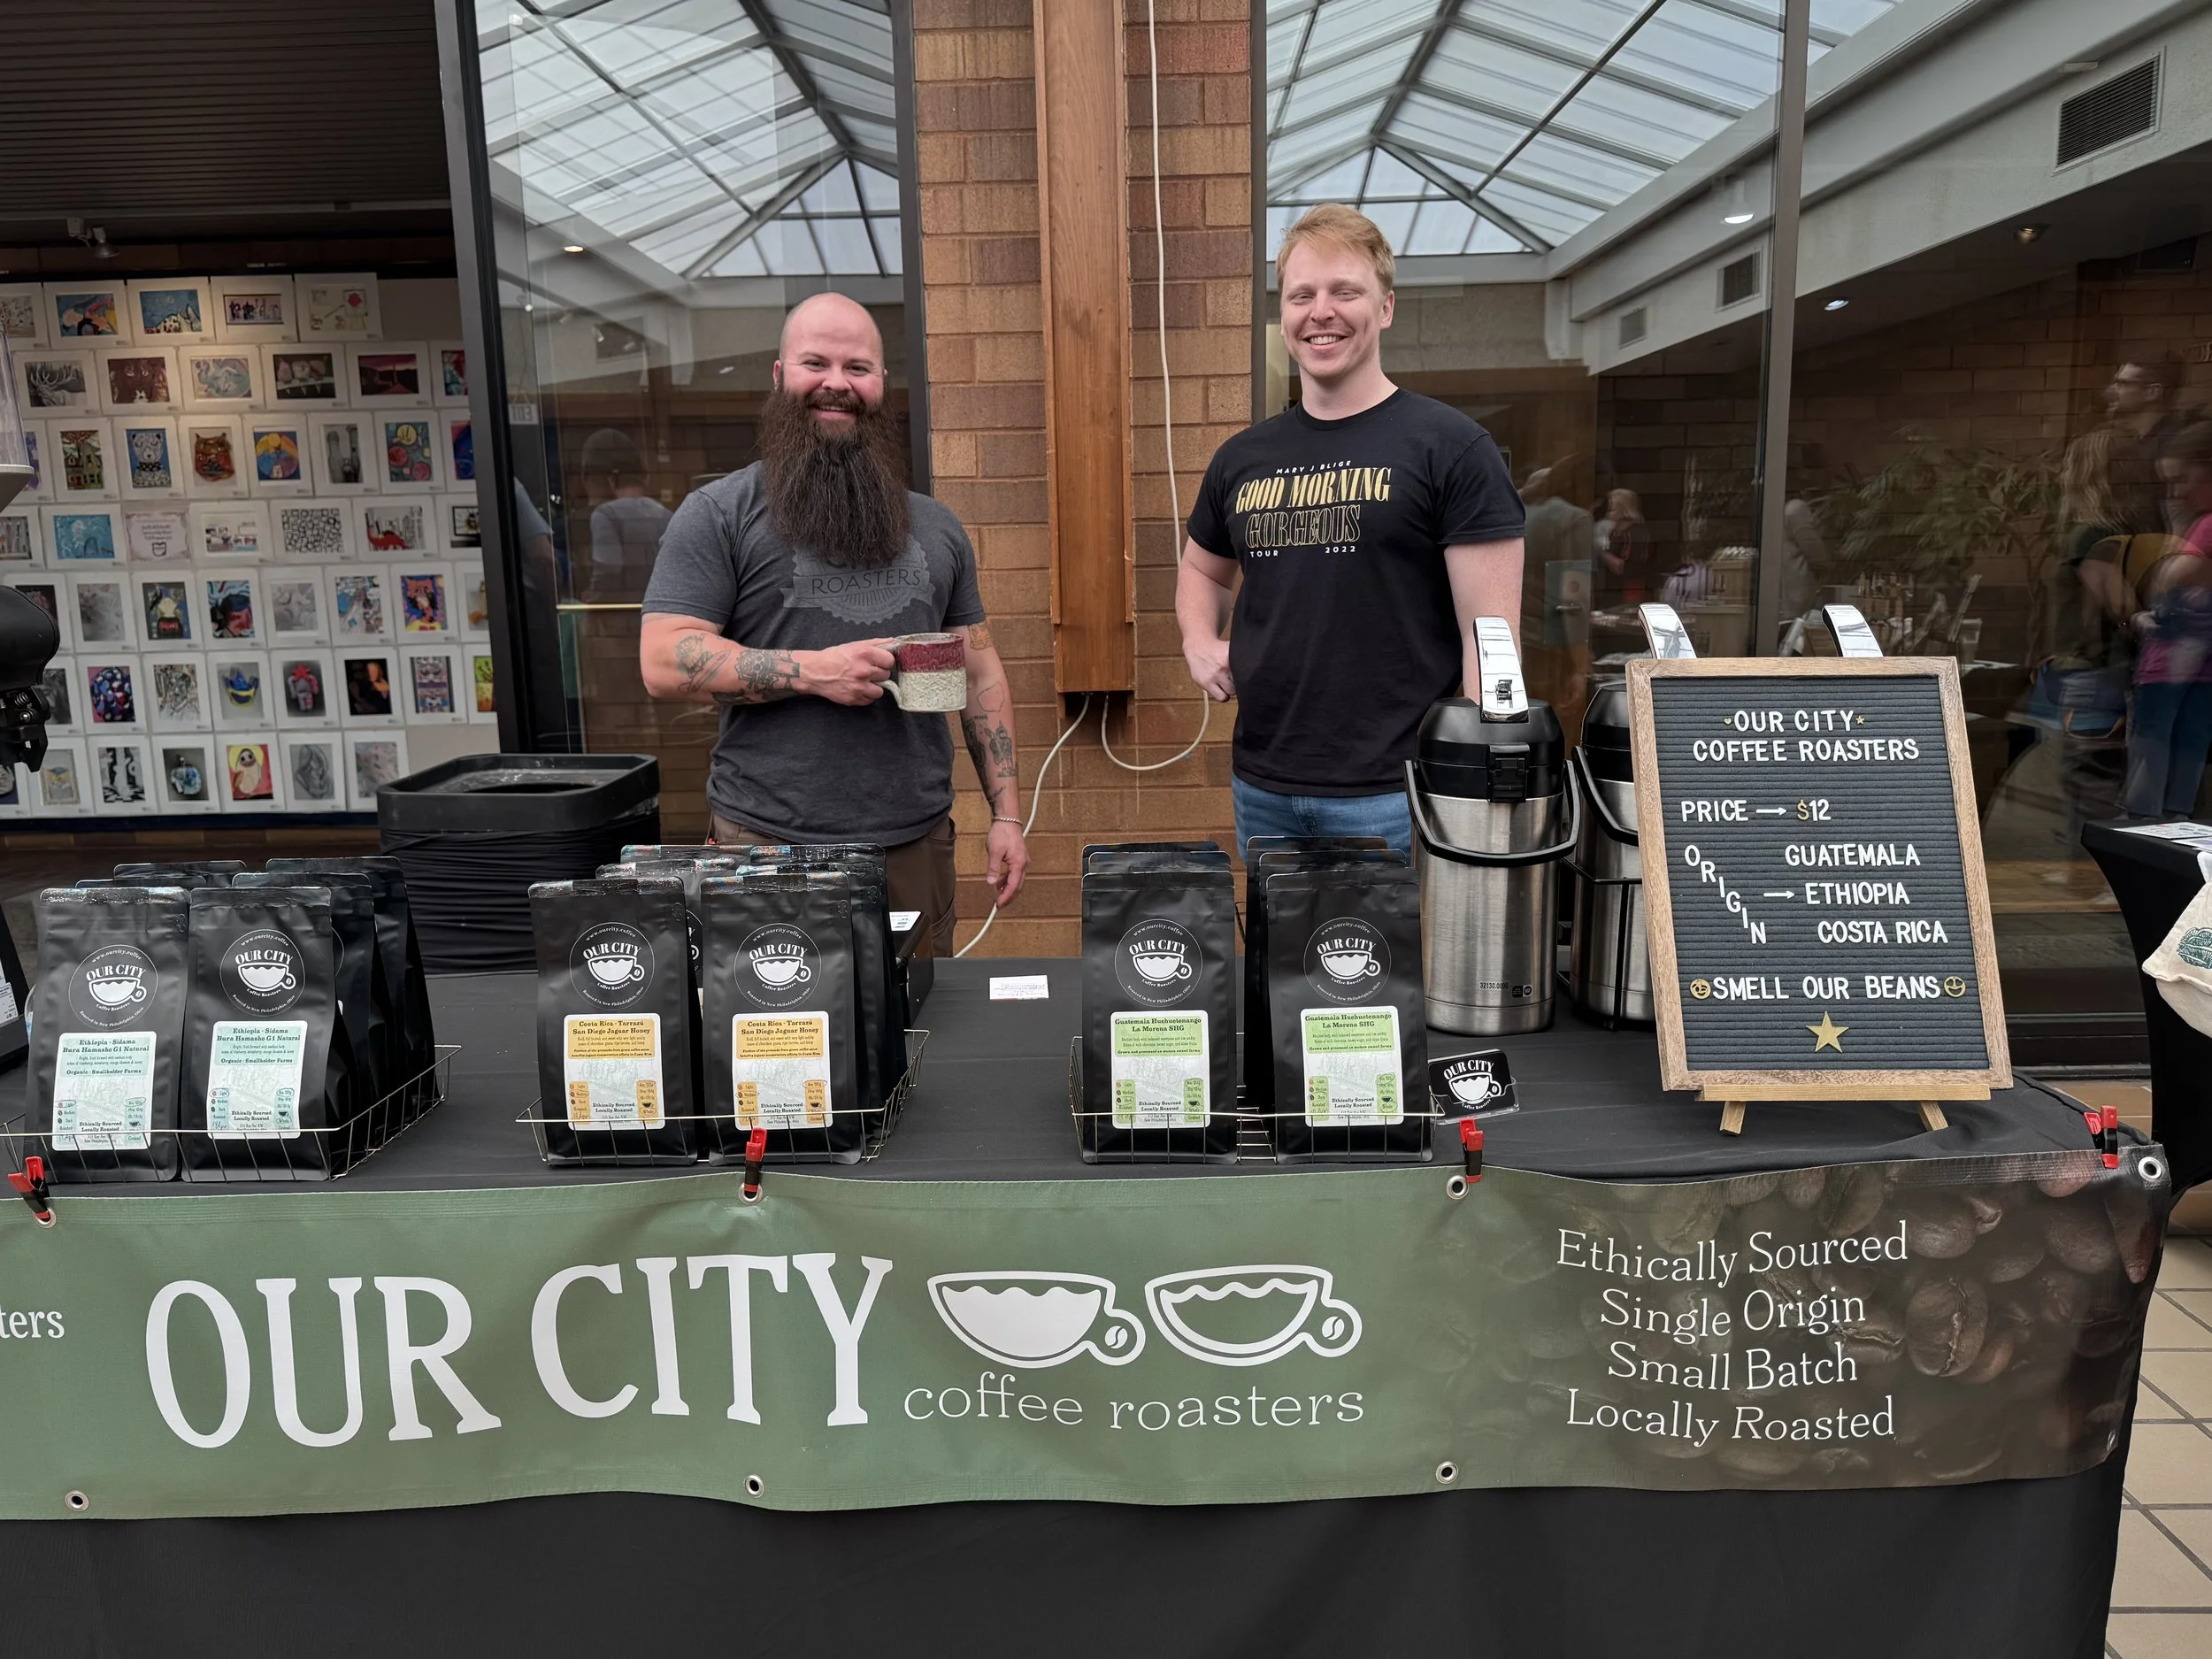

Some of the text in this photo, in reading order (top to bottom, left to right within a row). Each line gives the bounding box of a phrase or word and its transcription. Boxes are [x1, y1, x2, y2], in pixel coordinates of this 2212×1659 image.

[1320, 460, 1352, 470] BLIGE
[1236, 467, 1392, 514] GOOD MORNING
[1245, 504, 1361, 549] GORGEOUS
[811, 568, 921, 595] ROASTERS
[1733, 710, 1855, 733] OUR CITY
[1693, 738, 1919, 762] COFFEE ROASTERS
[1681, 799, 1832, 822] PRICE $12
[1786, 844, 1920, 867] GUATEMALA
[1685, 845, 1766, 944] ORIGIN
[1805, 882, 1910, 905] ETHIOPIA
[1817, 920, 1947, 944] COSTA RICA
[235, 949, 293, 964] OUR CITY
[583, 942, 641, 959] OUR CITY
[749, 943, 807, 960] OUR CITY
[1129, 940, 1188, 955] OUR CITY
[1317, 938, 1376, 954] OUR CITY
[86, 964, 146, 980] OUR CITY
[1712, 976, 1940, 1000] SMELL OUR BEANS
[1444, 1060, 1494, 1079] OUR CITY
[1556, 1220, 1909, 1288] Ethically Sourced
[1600, 1286, 1866, 1345] Single Origin
[145, 1252, 893, 1448] OUR CITY
[1608, 1341, 1858, 1391] Small Batch
[903, 1371, 1364, 1431] coffee roasters
[1567, 1388, 1894, 1448] Locally Roasted
